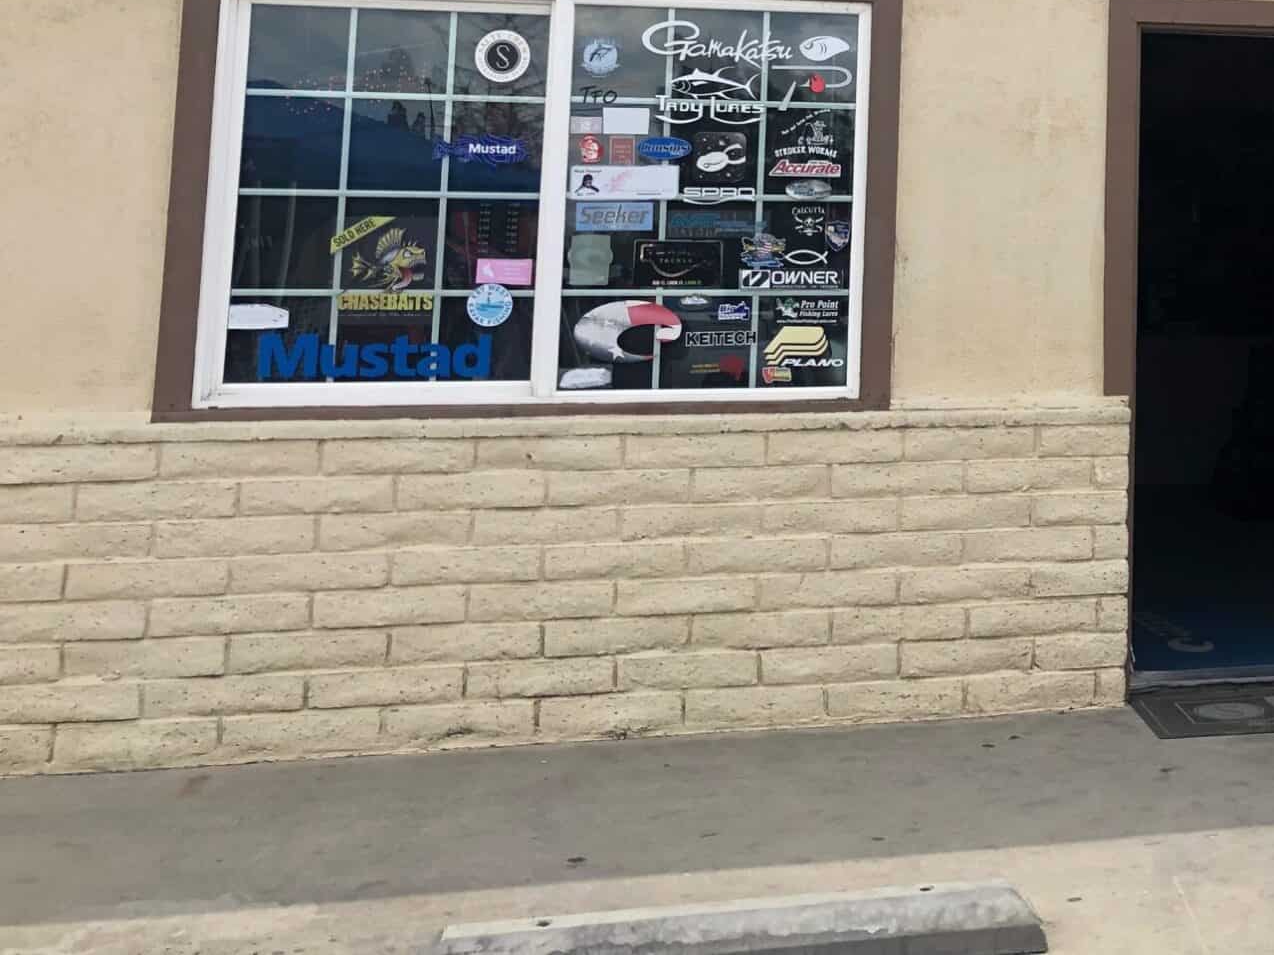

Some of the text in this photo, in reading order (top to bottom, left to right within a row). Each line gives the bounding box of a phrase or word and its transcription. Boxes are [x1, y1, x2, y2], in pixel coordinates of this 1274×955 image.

[468, 143, 517, 155] Mustad
[770, 160, 841, 175] Accurate
[579, 203, 648, 225] Seeker
[792, 206, 825, 216] CALCUTTA
[333, 218, 377, 247] SOLD HERE
[771, 271, 839, 285] OWNER
[338, 292, 433, 311] CHASEBAITS
[800, 299, 839, 309] Pro Point
[685, 331, 757, 347] KEITECH
[257, 332, 493, 381] Mustad
[781, 359, 844, 367] PLANO
